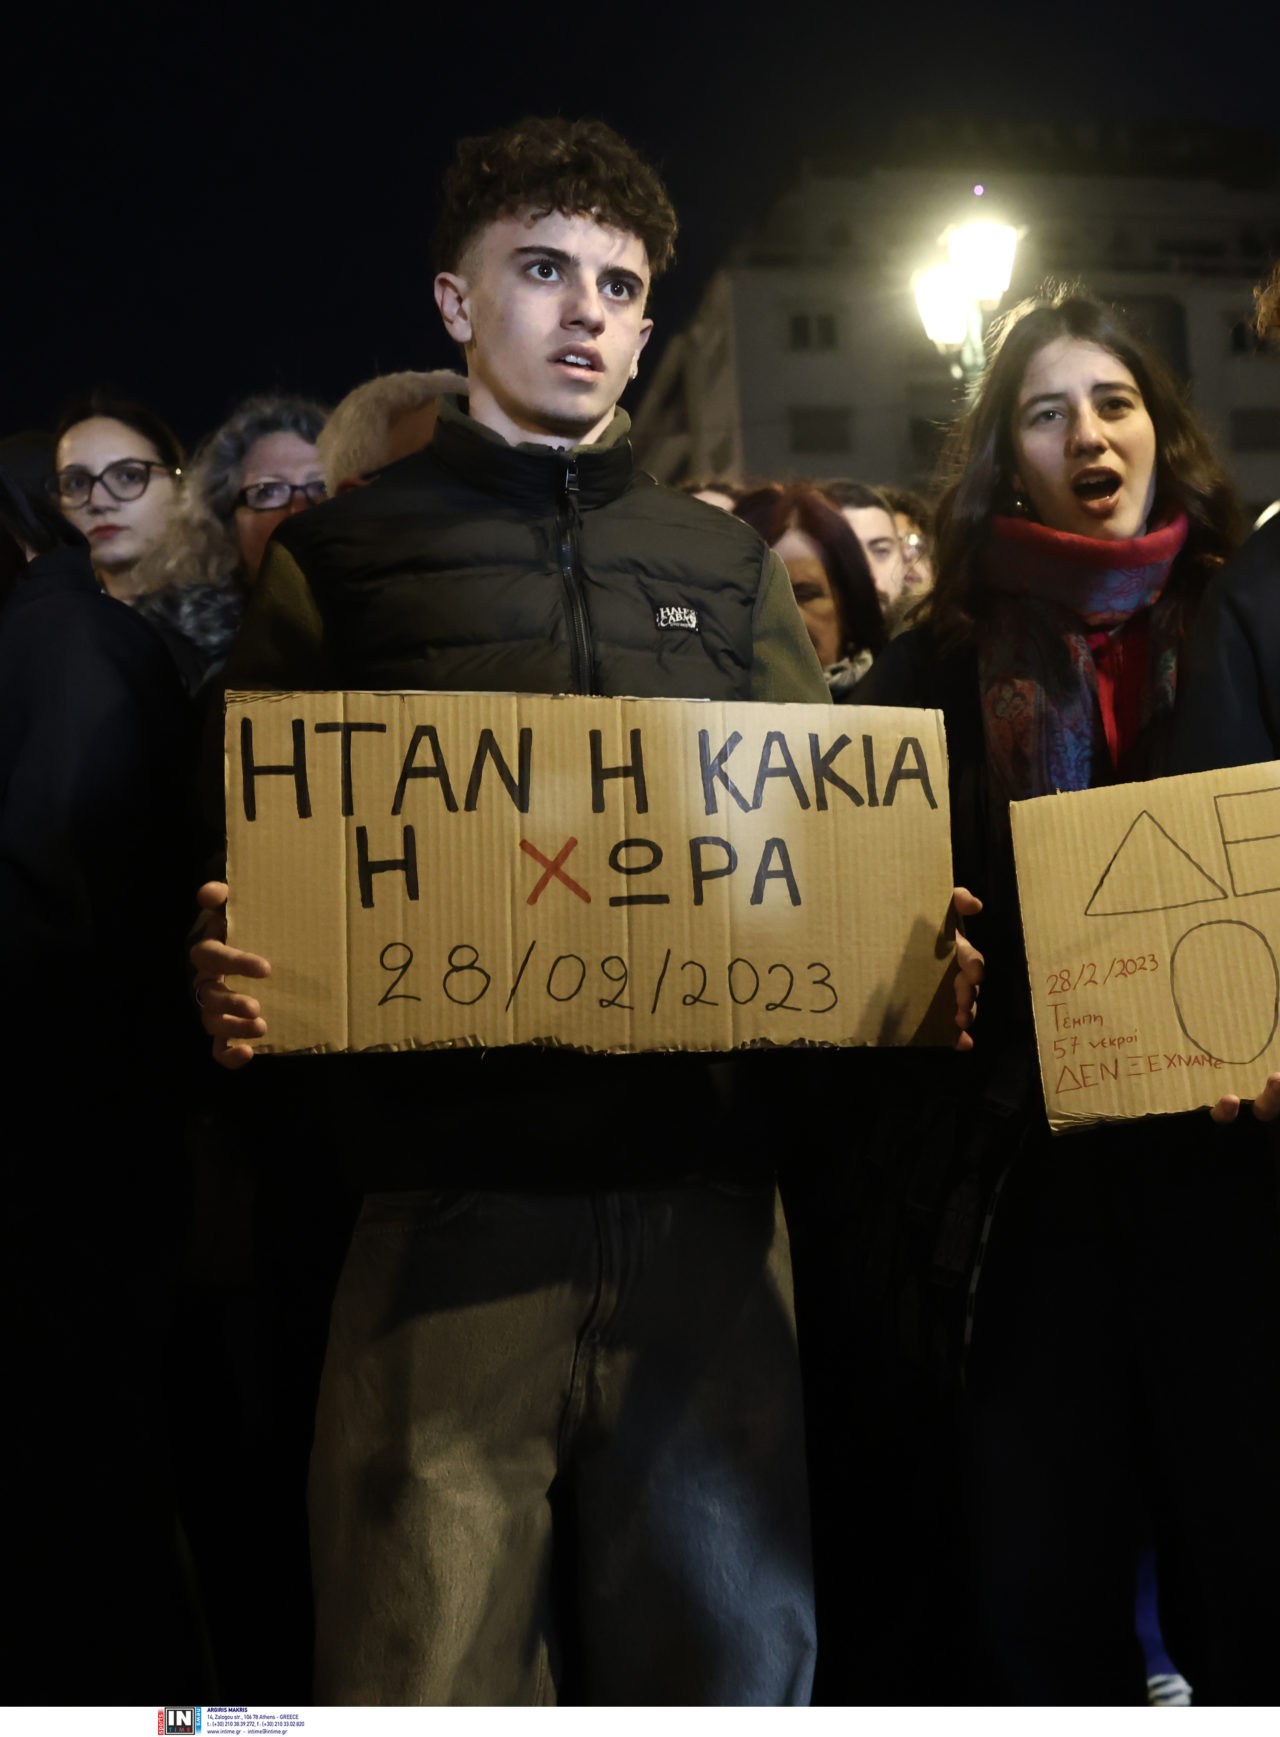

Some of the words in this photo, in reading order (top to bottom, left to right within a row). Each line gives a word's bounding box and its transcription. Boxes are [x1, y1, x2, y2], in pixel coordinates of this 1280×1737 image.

[240, 717, 533, 822] ΗΤΑΝ
[589, 728, 649, 814] Η
[699, 729, 938, 815] ΚΑΚΙΑ
[355, 825, 420, 908] Η
[377, 940, 839, 1015] 28/02/2023
[1053, 1036, 1081, 1060] 57
